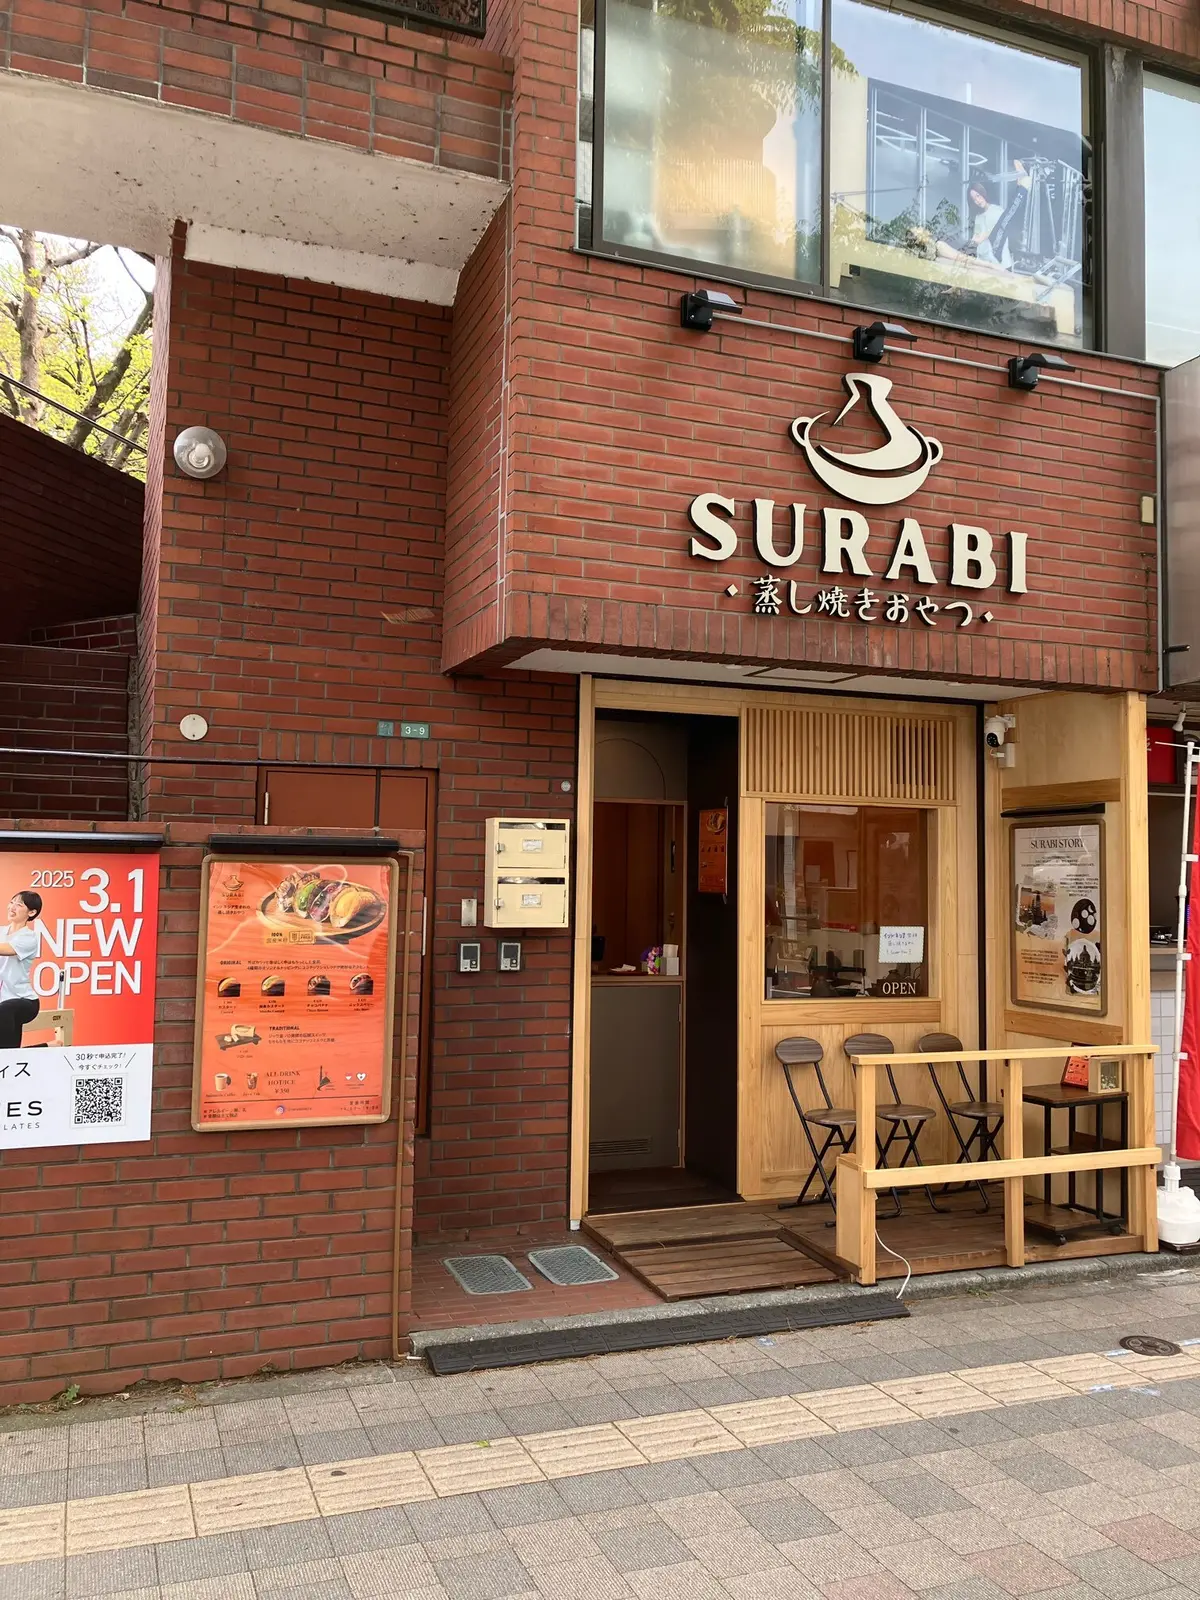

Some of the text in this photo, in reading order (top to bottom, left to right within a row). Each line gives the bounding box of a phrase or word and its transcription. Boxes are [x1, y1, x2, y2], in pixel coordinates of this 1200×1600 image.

[688, 492, 1029, 594] SURABI
[405, 726, 425, 735] 3-9
[1030, 838, 1085, 849] SURABI STORY
[30, 868, 144, 914] 2025 3.1
[33, 918, 144, 958] NEW
[33, 961, 141, 996] OPEN
[882, 981, 916, 995] OPEN
